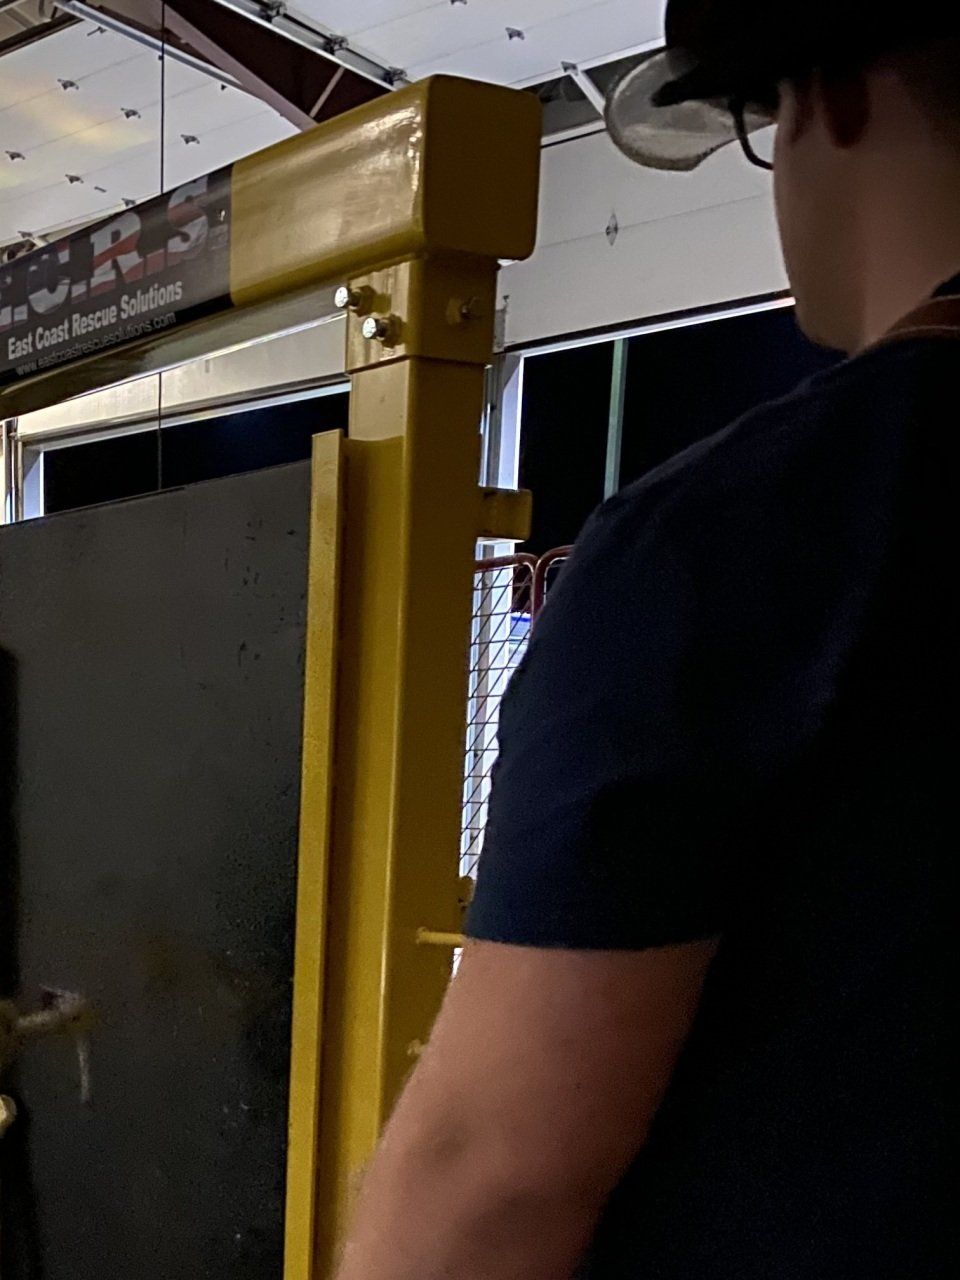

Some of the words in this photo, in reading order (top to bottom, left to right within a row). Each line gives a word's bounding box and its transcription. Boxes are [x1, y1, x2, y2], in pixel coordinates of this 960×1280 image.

[8, 334, 33, 360] East
[35, 321, 70, 349] Coast
[72, 305, 117, 335] Rescue
[121, 281, 182, 321] Solutions
